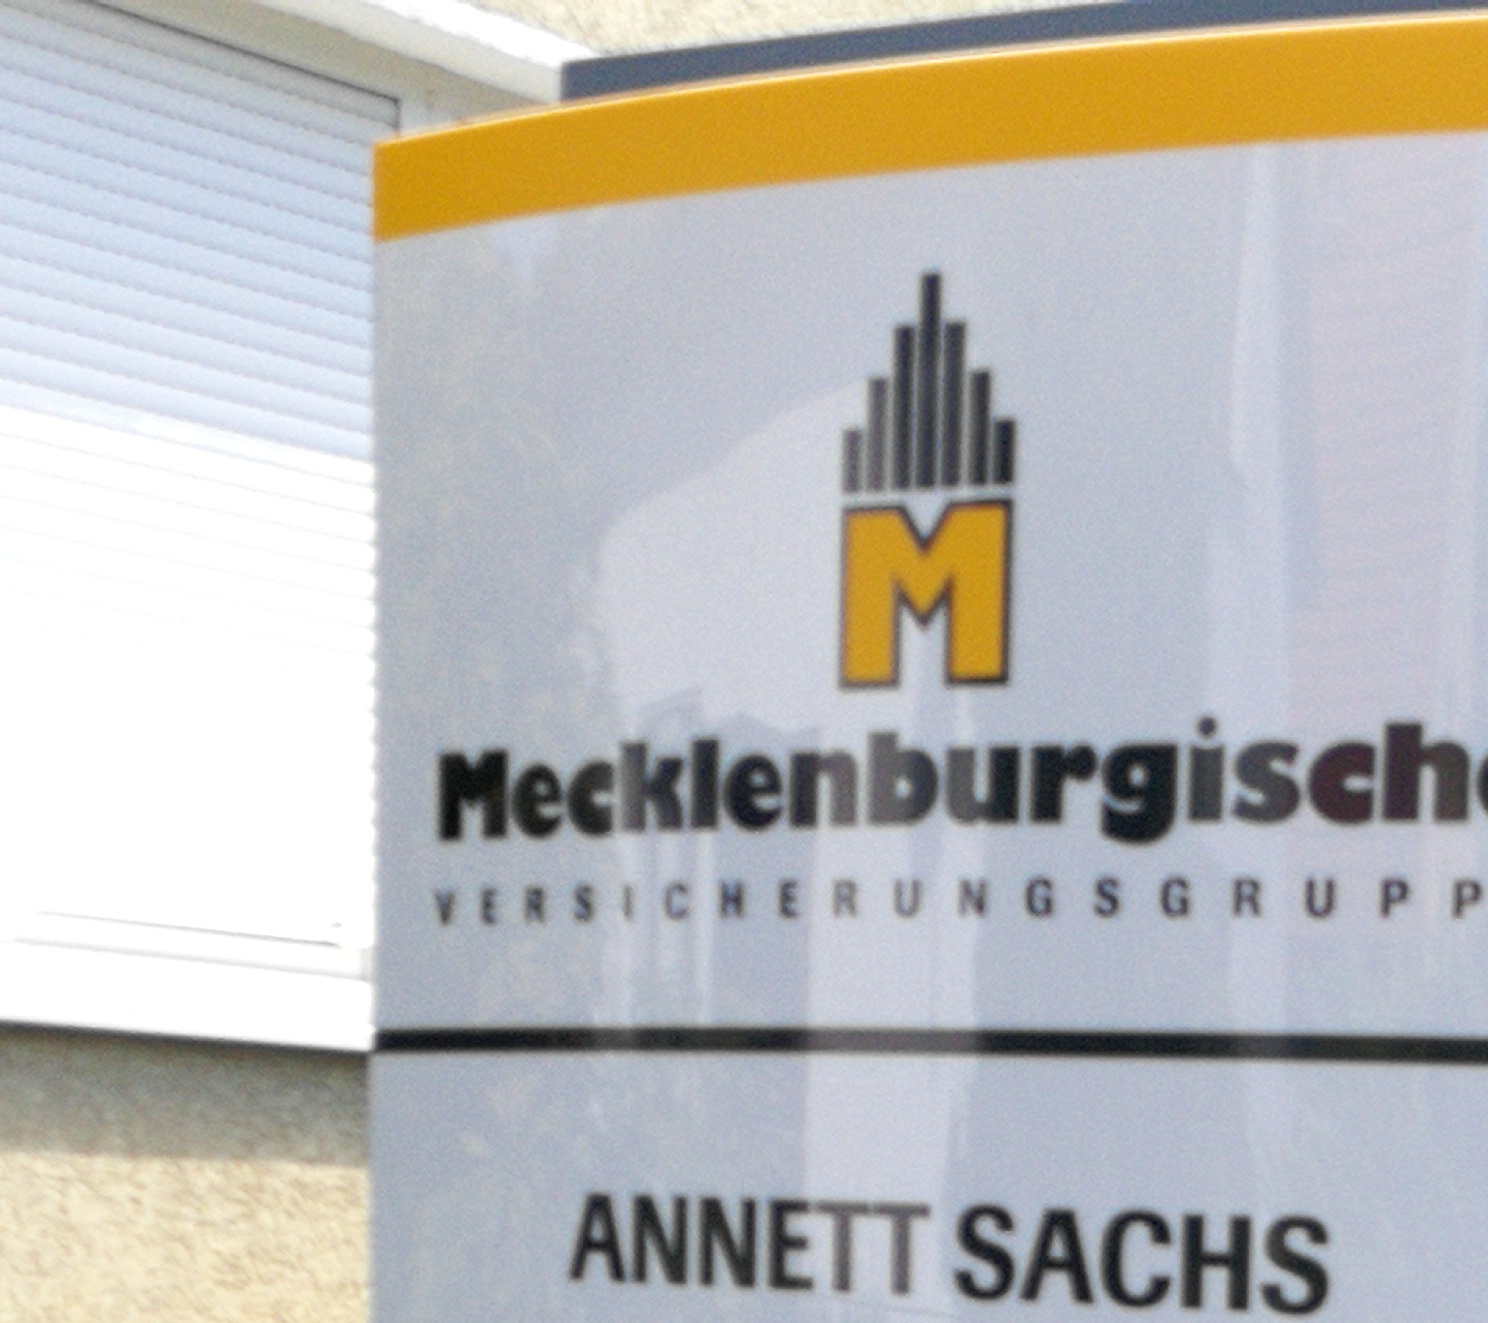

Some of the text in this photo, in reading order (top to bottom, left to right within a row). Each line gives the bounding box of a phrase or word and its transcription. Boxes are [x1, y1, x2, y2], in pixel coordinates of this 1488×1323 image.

[839, 499, 1013, 690] M
[568, 1194, 1330, 1318] ANNETT SACHS
